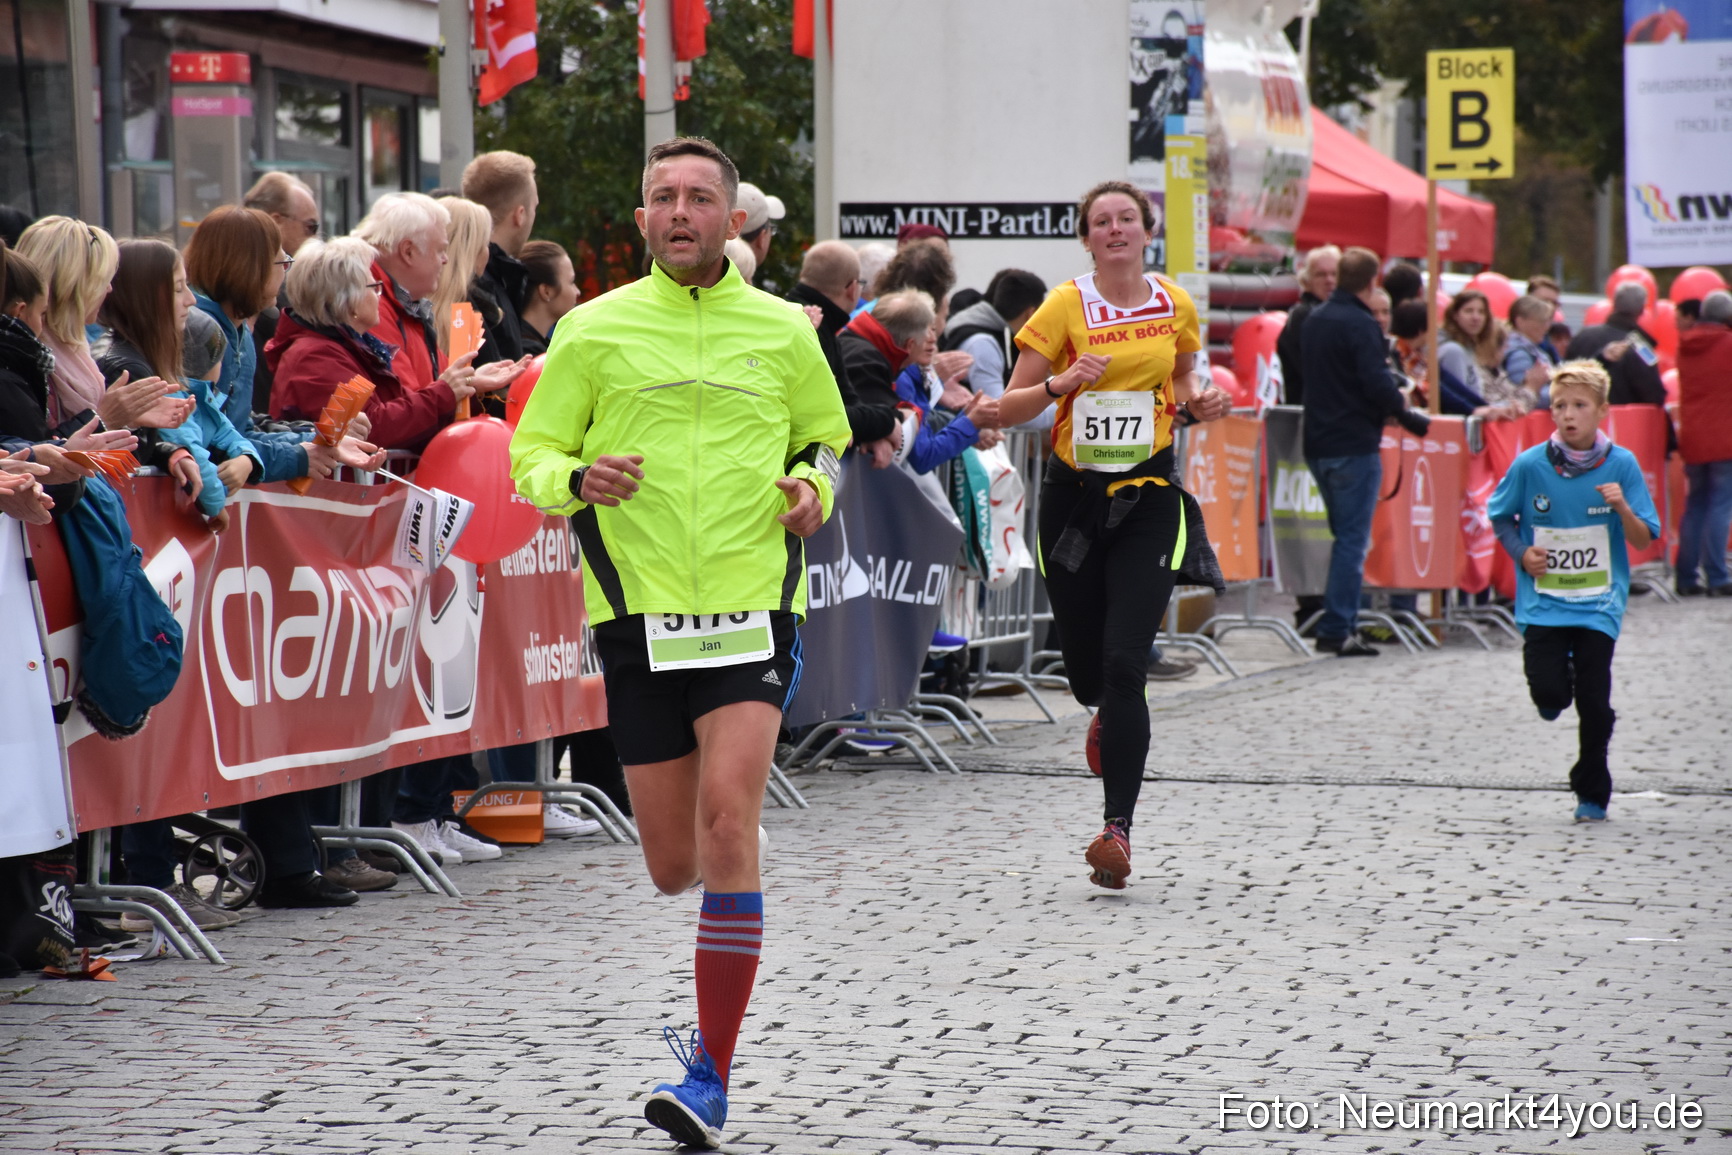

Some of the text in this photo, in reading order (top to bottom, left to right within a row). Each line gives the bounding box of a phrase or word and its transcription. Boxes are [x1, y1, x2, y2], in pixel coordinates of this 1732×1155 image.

[1438, 56, 1503, 79] Block
[1450, 90, 1491, 150] B
[840, 206, 1079, 235] www.MINI-Partl.d
[1088, 323, 1178, 347] MAX BÖGL
[1085, 416, 1142, 440] 5177
[1093, 449, 1135, 458] Christiane
[409, 500, 424, 545] swn
[442, 496, 460, 538] swn
[1547, 548, 1598, 570] 5202
[700, 641, 722, 652] Jan
[523, 632, 578, 686] schönsten
[761, 677, 782, 686] adidas
